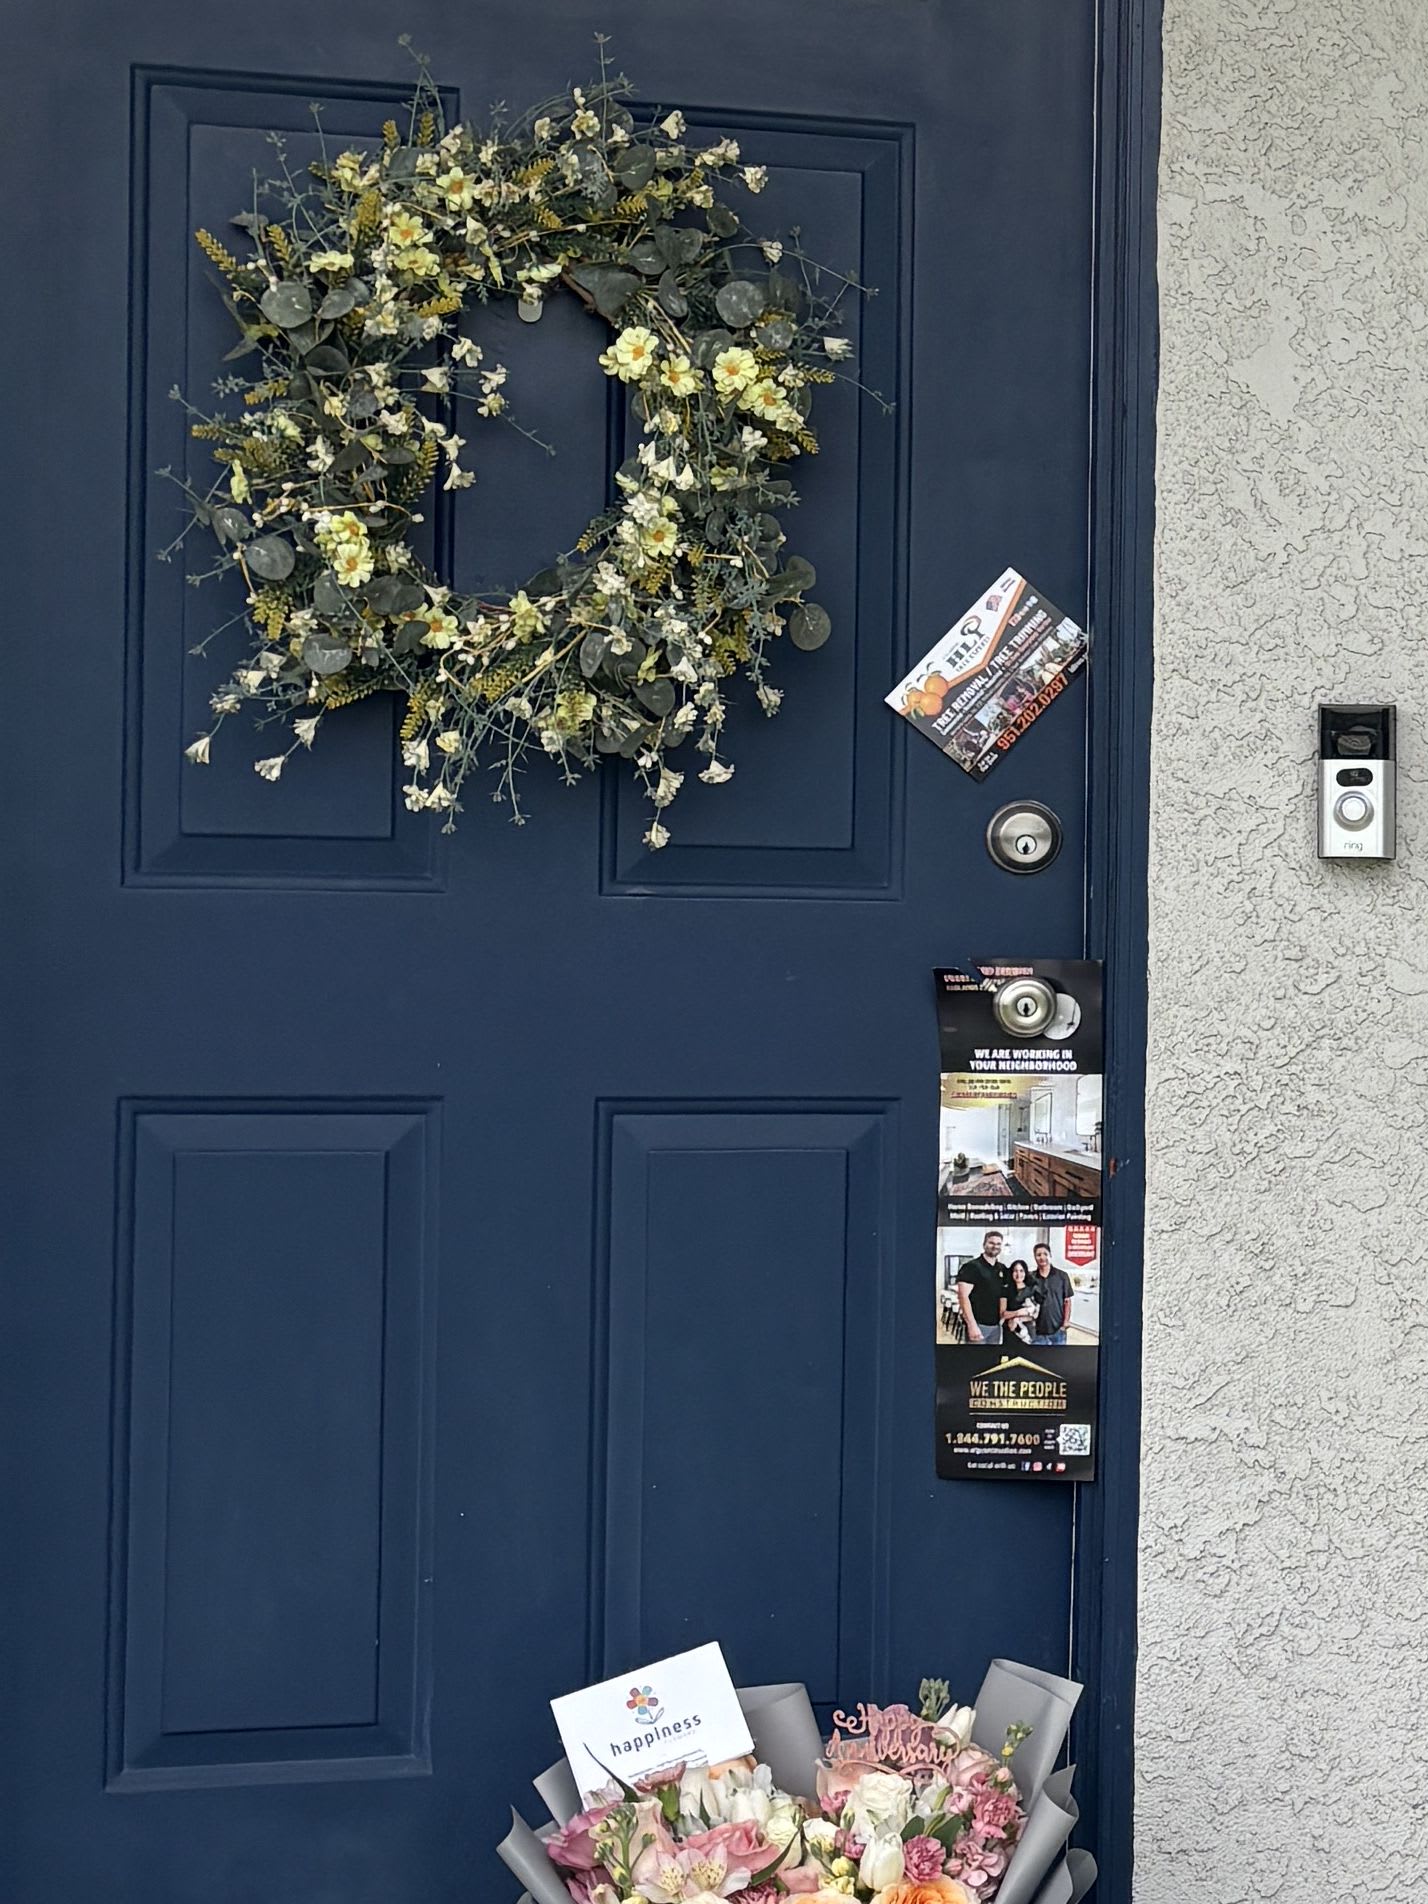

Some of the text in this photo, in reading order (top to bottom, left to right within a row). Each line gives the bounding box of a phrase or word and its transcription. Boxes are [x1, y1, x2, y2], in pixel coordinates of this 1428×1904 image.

[931, 706, 956, 730] TREE
[953, 673, 989, 711] REMOVAL
[991, 647, 1014, 669] TREE
[1009, 609, 1048, 649] TRIMMING
[997, 672, 1069, 750] 951.202.0297
[974, 1049, 1073, 1060] WE ARE WORKING IN
[970, 1061, 1077, 1071] YOUR NEIGHBORHOOD
[970, 1381, 1067, 1397] WE THE PEOPLE
[971, 1399, 1065, 1408] CONSTRUCTION
[610, 1714, 702, 1757] happiness
